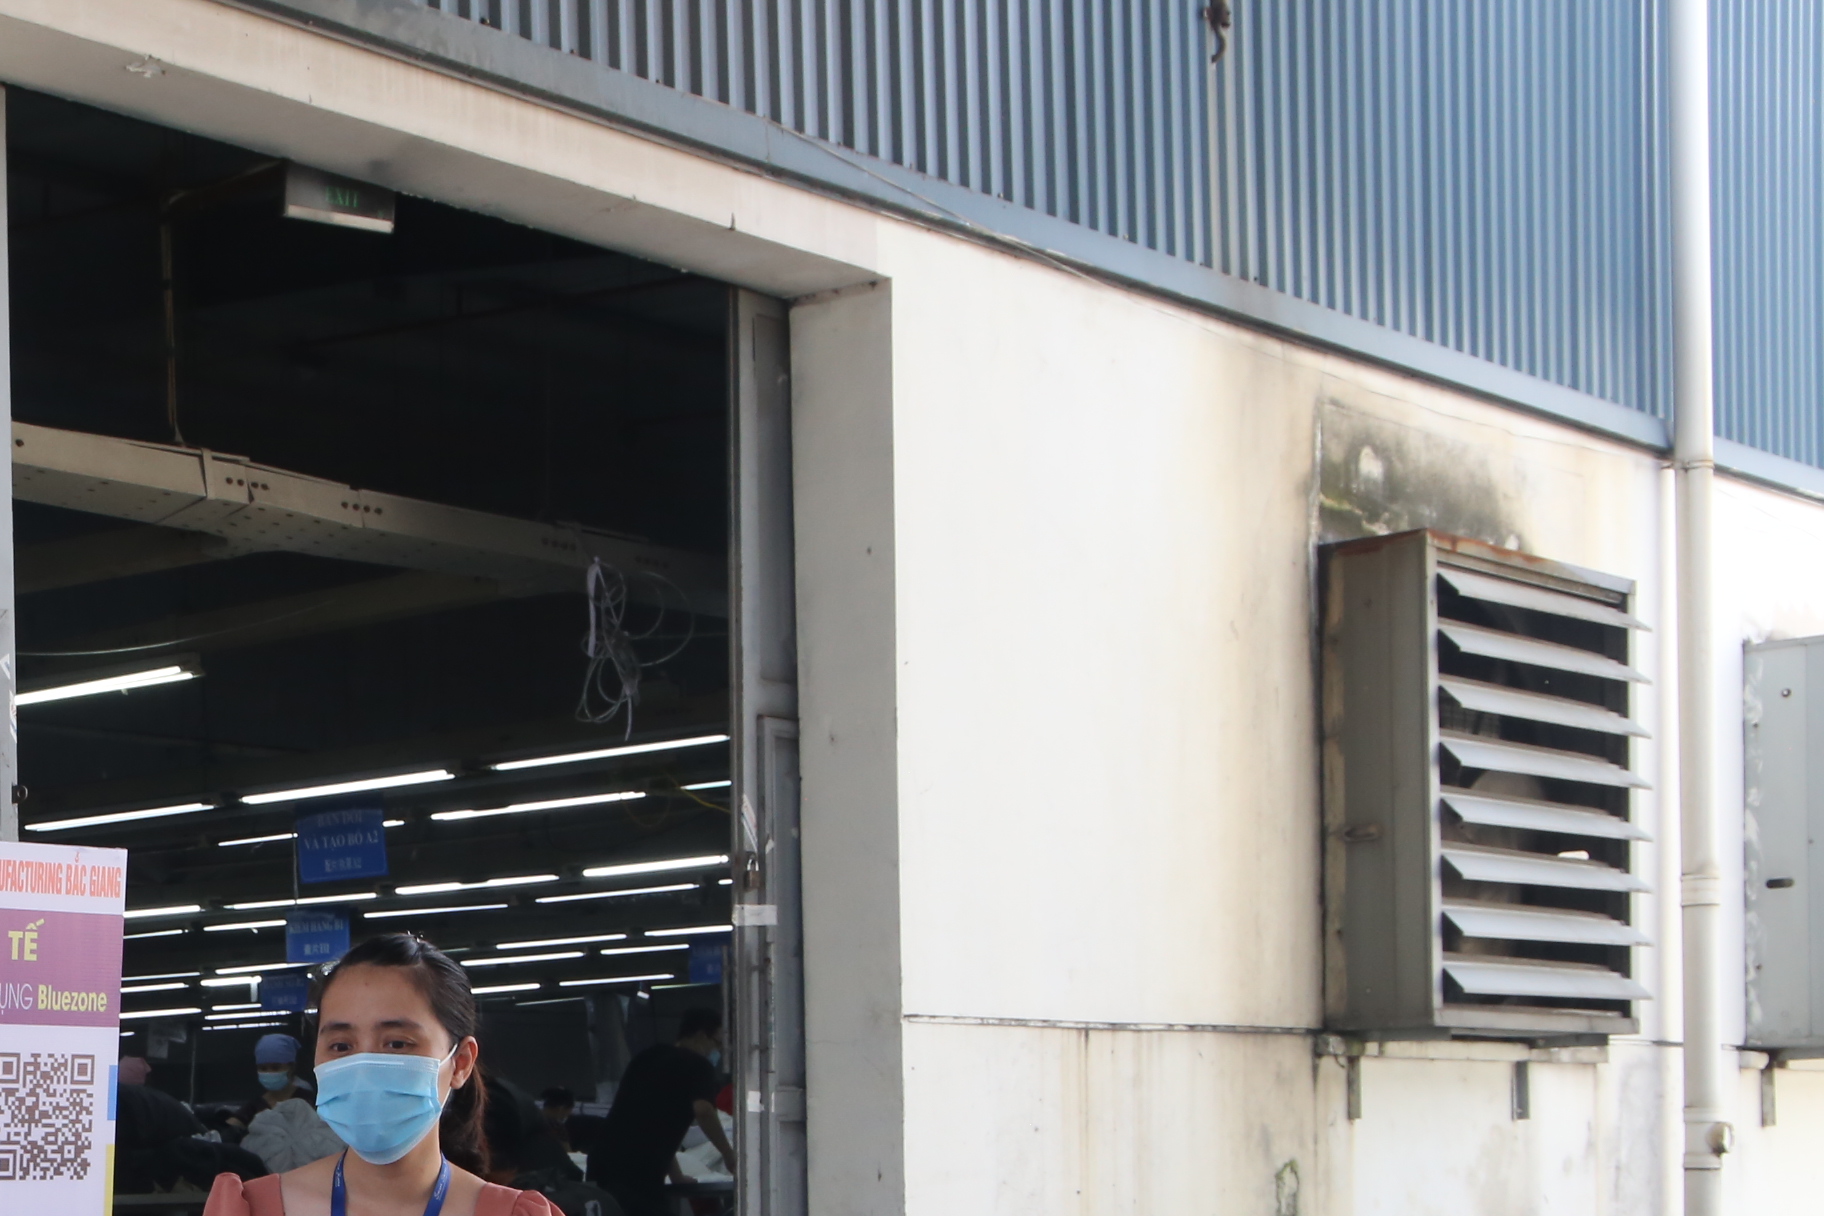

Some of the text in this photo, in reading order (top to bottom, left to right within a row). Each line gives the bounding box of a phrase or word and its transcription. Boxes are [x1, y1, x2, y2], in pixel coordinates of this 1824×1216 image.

[66, 852, 87, 896] BẮC
[90, 865, 122, 898] GIANG
[8, 918, 45, 961] TẾ
[37, 984, 107, 1012] Bluezone
